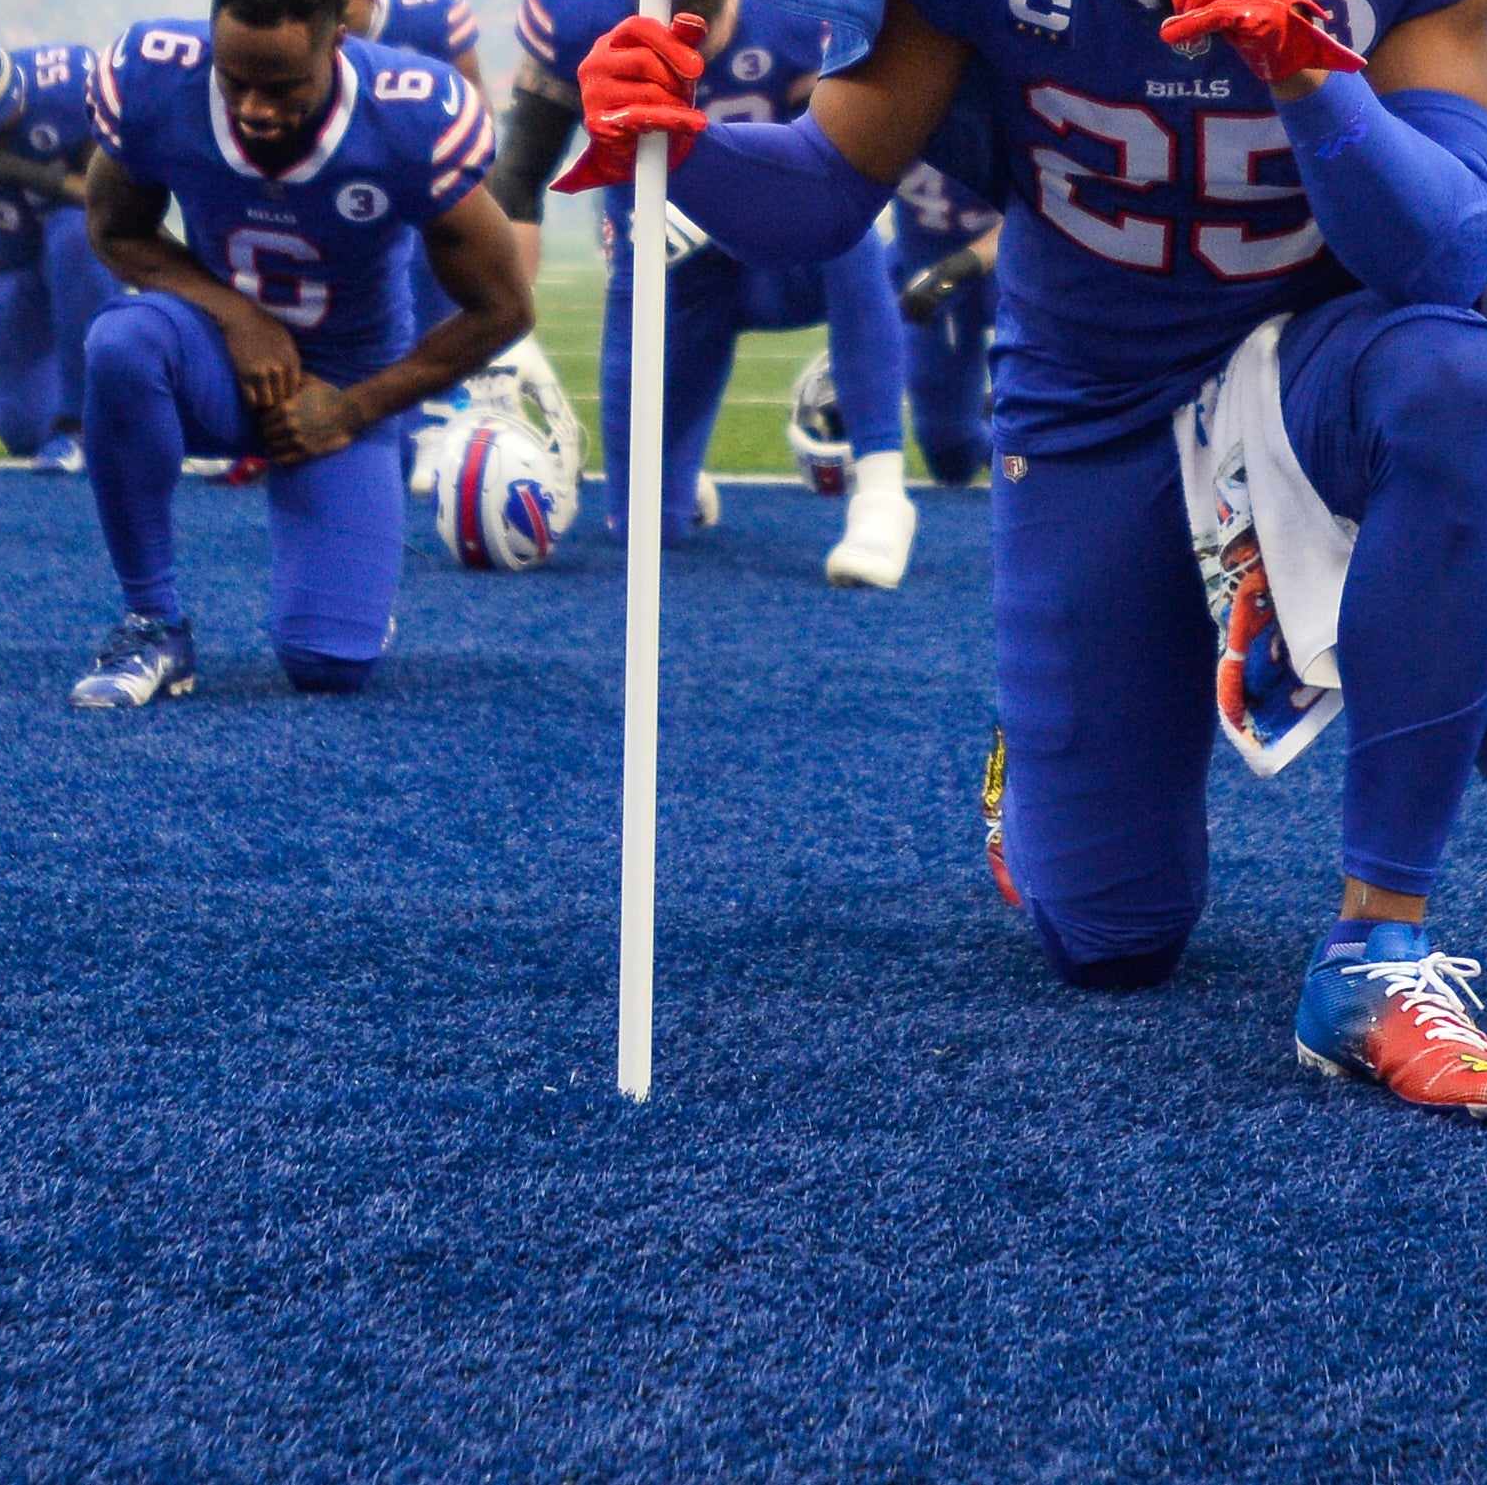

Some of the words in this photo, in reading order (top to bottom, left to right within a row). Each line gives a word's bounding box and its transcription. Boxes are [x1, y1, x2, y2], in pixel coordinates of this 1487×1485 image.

[141, 29, 201, 66] 6
[35, 49, 71, 88] 55
[374, 69, 435, 102] 6
[1145, 79, 1231, 99] BILLS
[1023, 80, 1327, 284] 25
[349, 188, 375, 219] 3
[226, 227, 330, 329] 6
